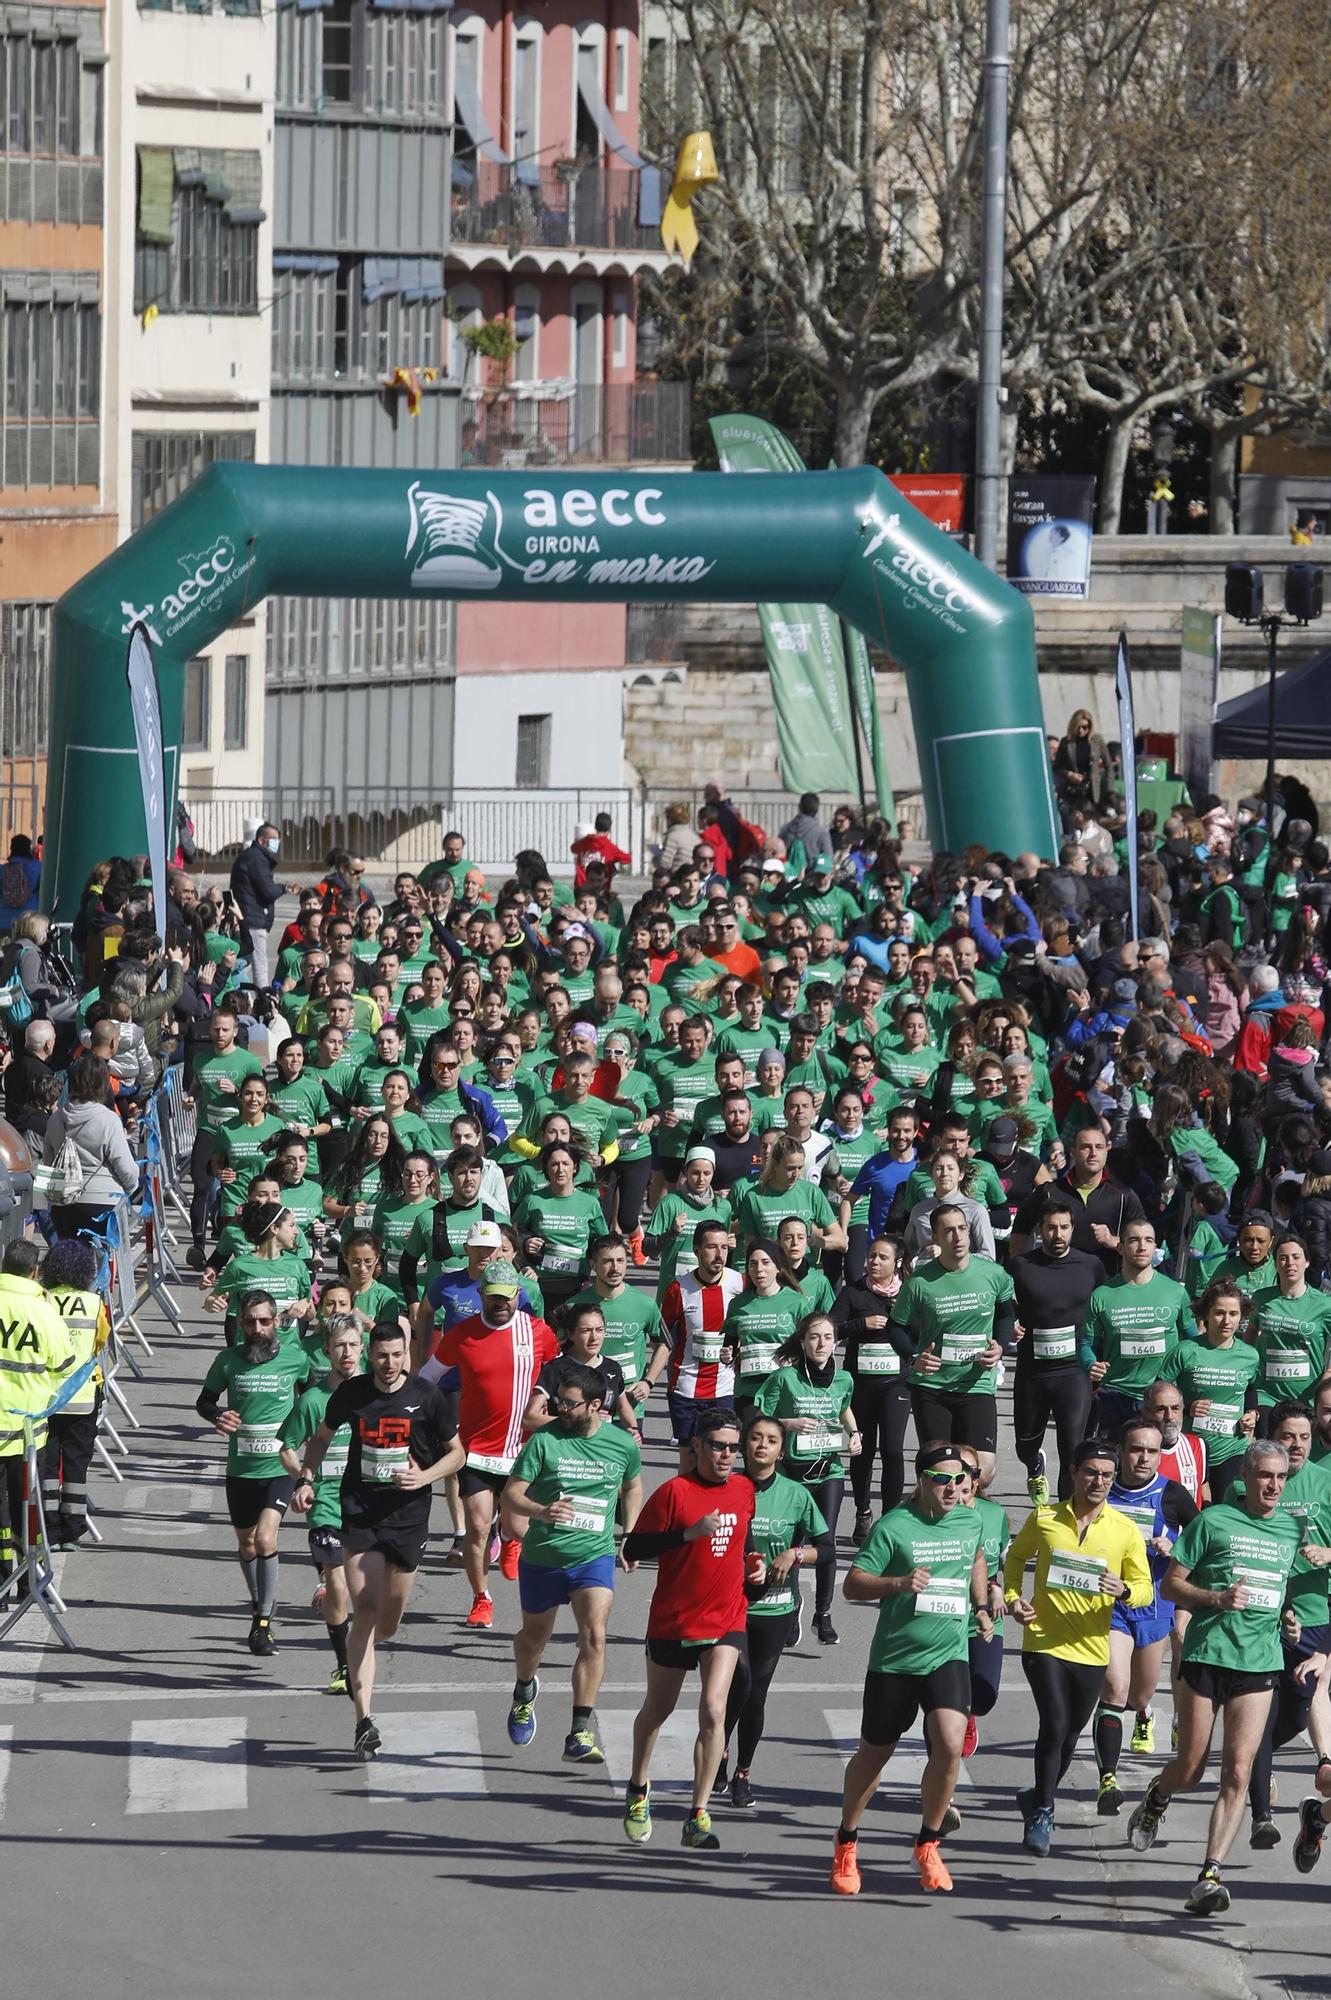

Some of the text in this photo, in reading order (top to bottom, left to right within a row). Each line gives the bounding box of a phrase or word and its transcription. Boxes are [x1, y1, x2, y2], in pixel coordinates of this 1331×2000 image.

[523, 488, 666, 527] aecc
[525, 535, 600, 554] GIRONA
[523, 558, 583, 583] en
[160, 547, 235, 619] aecc
[892, 549, 976, 613] aecc
[935, 1295, 960, 1303] Tradeinn
[54, 1296, 87, 1316] YA
[936, 1308, 954, 1316] Contra
[0, 1318, 39, 1353] YA
[701, 1348, 721, 1358] 161
[1044, 1345, 1067, 1355] 1523
[1132, 1345, 1155, 1354] 1640
[953, 1352, 976, 1361] 1408
[749, 1362, 772, 1371] 1552
[868, 1361, 891, 1370] 1606
[1193, 1365, 1220, 1374] Tradeinn
[1275, 1367, 1300, 1377] 1614
[1192, 1378, 1211, 1386] Contra
[1205, 1421, 1228, 1433] 1478
[248, 1443, 273, 1452] 1403
[808, 1438, 832, 1449] 1404
[480, 1457, 503, 1470] 1536
[557, 1457, 585, 1465] Tradeinn
[569, 1517, 595, 1530] 1568
[715, 1526, 733, 1537] un
[711, 1537, 730, 1546] run
[1229, 1536, 1260, 1545] Tradeinn
[1229, 1543, 1252, 1552] Girona
[1259, 1547, 1278, 1556] marxa
[1230, 1550, 1251, 1558] Contra
[1251, 1552, 1257, 1560] el
[1061, 1573, 1090, 1589] 1566
[1248, 1593, 1270, 1606] 554
[929, 1600, 957, 1613] 1506
